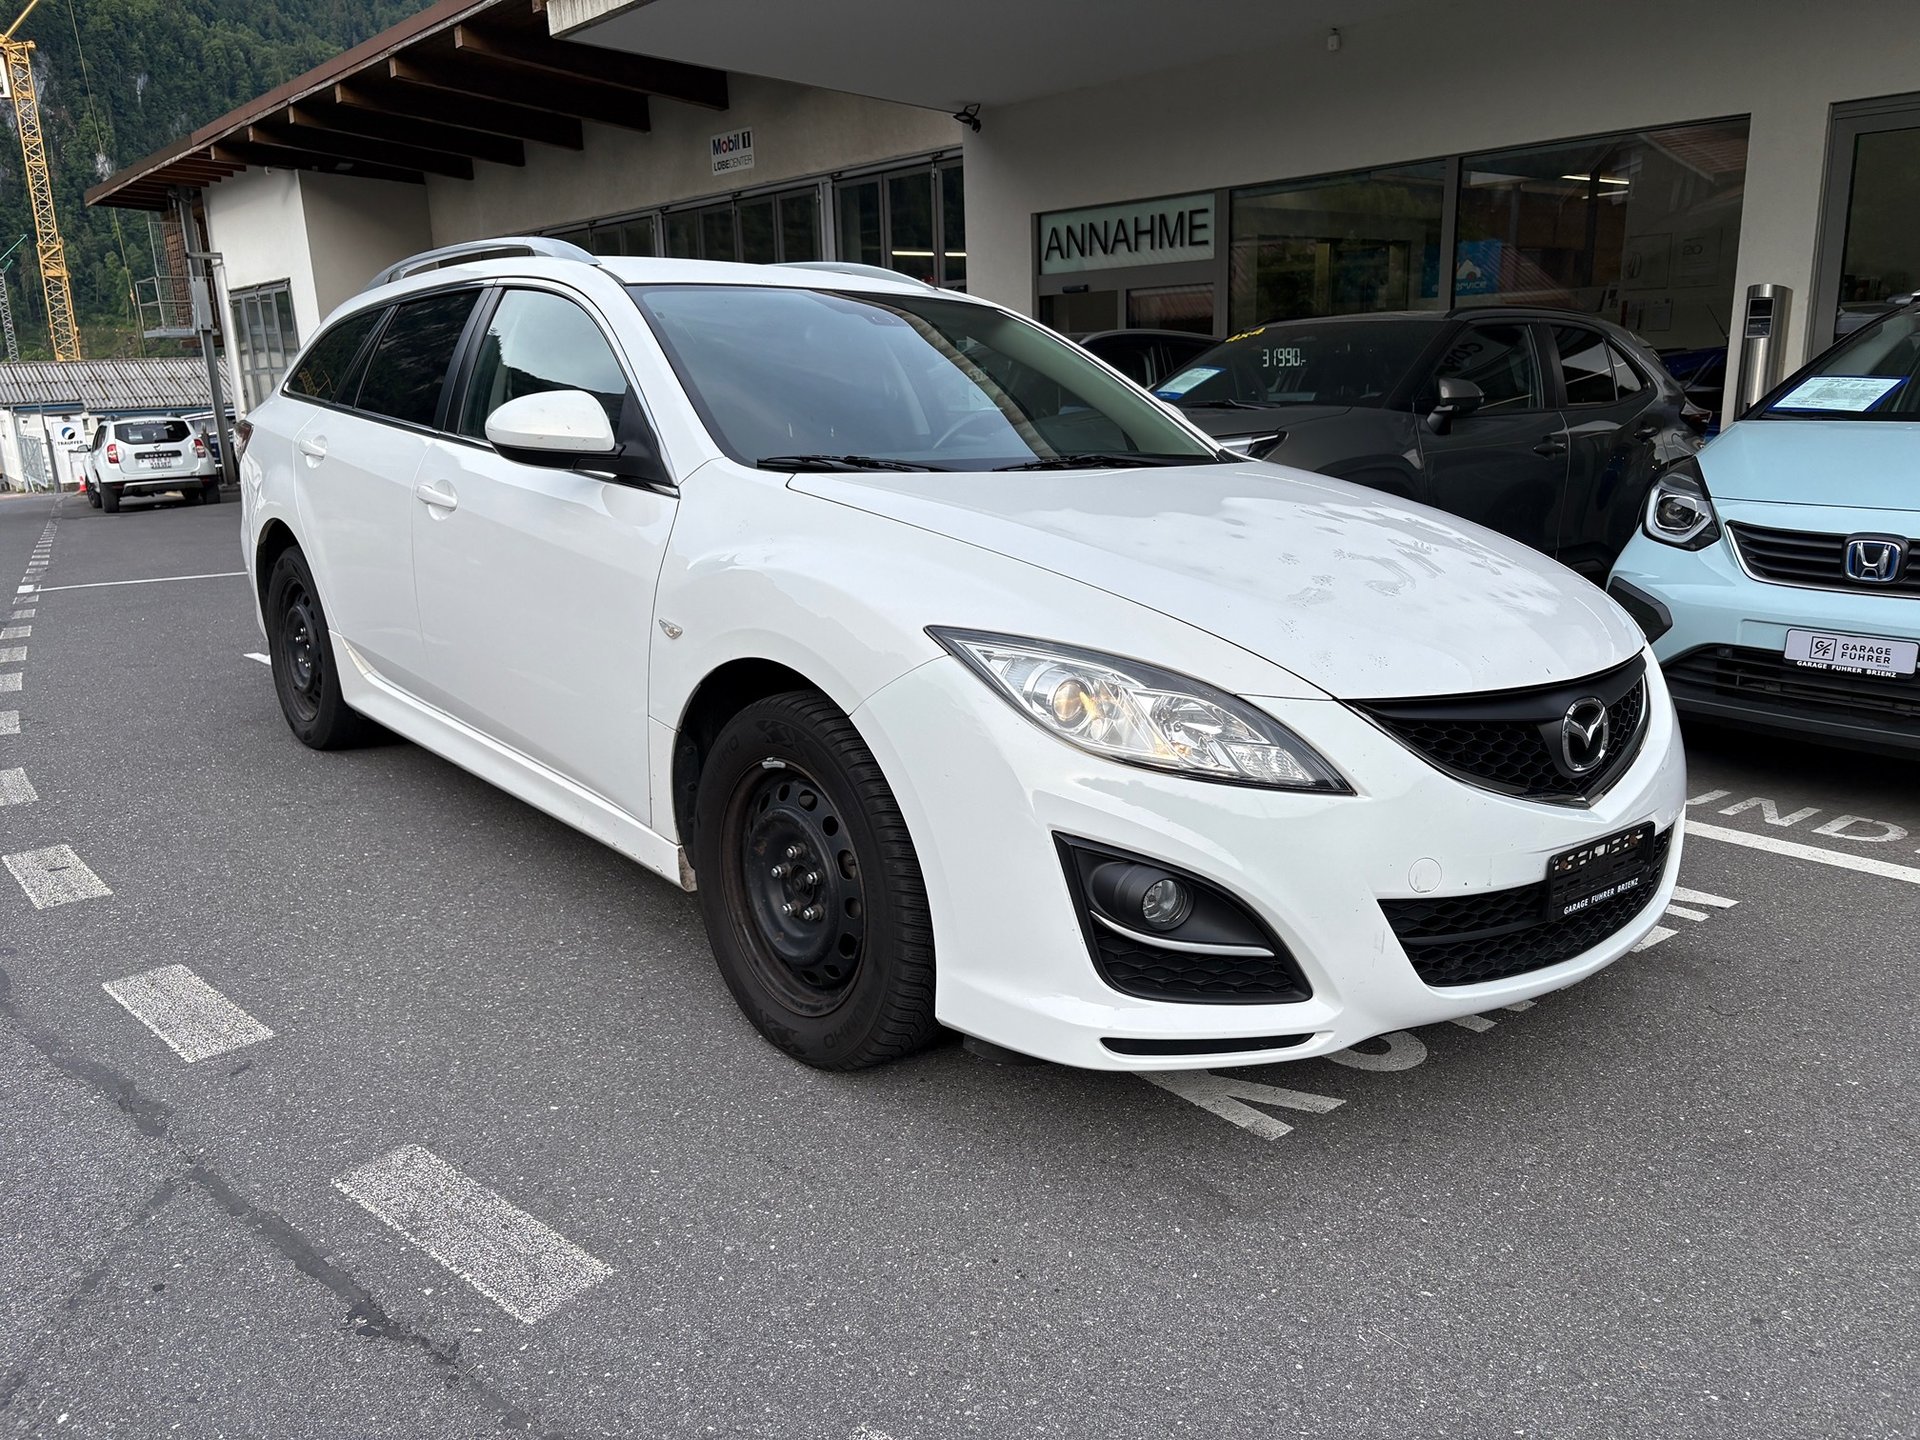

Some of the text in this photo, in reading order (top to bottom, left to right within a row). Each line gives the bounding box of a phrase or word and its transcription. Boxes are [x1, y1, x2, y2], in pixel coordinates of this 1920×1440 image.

[712, 133, 740, 155] Mobil
[1044, 208, 1209, 261] ANNAHME
[1840, 651, 1892, 665] FUHRER
[1841, 643, 1892, 656] GARAGE
[1796, 660, 1897, 678] GARAGE FUHRER BRIENZ
[1563, 877, 1639, 915] GARAGE FUHRER BRIENZ
